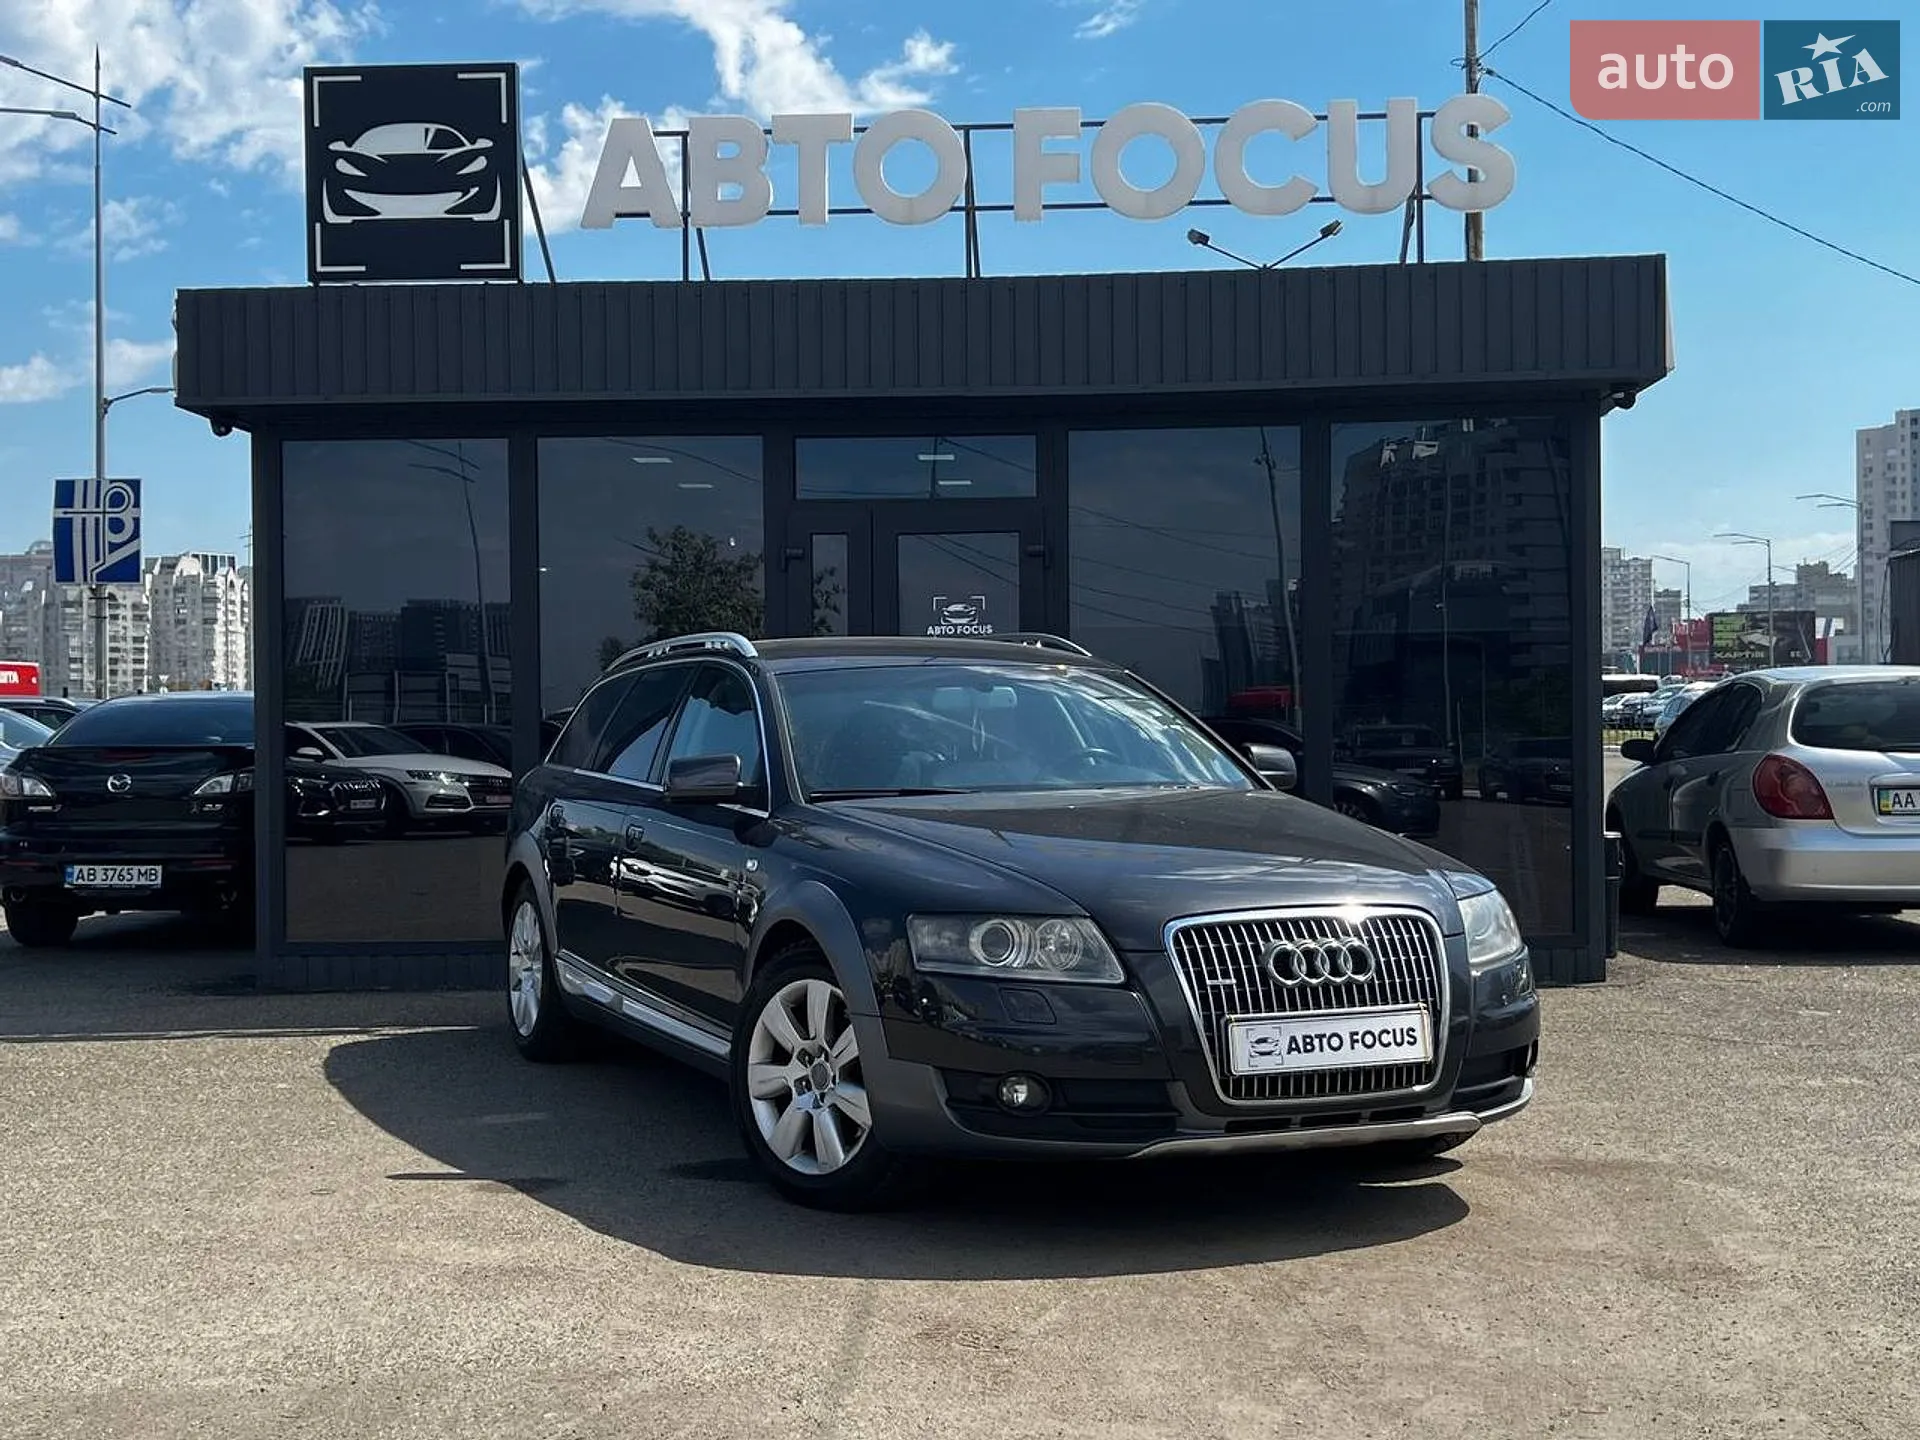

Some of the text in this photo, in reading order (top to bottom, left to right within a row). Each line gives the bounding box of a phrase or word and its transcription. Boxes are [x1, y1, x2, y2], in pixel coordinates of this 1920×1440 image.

[580, 94, 1516, 229] АВТО FOCUS
[956, 624, 993, 635] FOCUS
[1892, 792, 1915, 807] AA
[76, 868, 158, 882] AB 3765 MB
[1286, 1027, 1417, 1055] АВТО FOCUS
